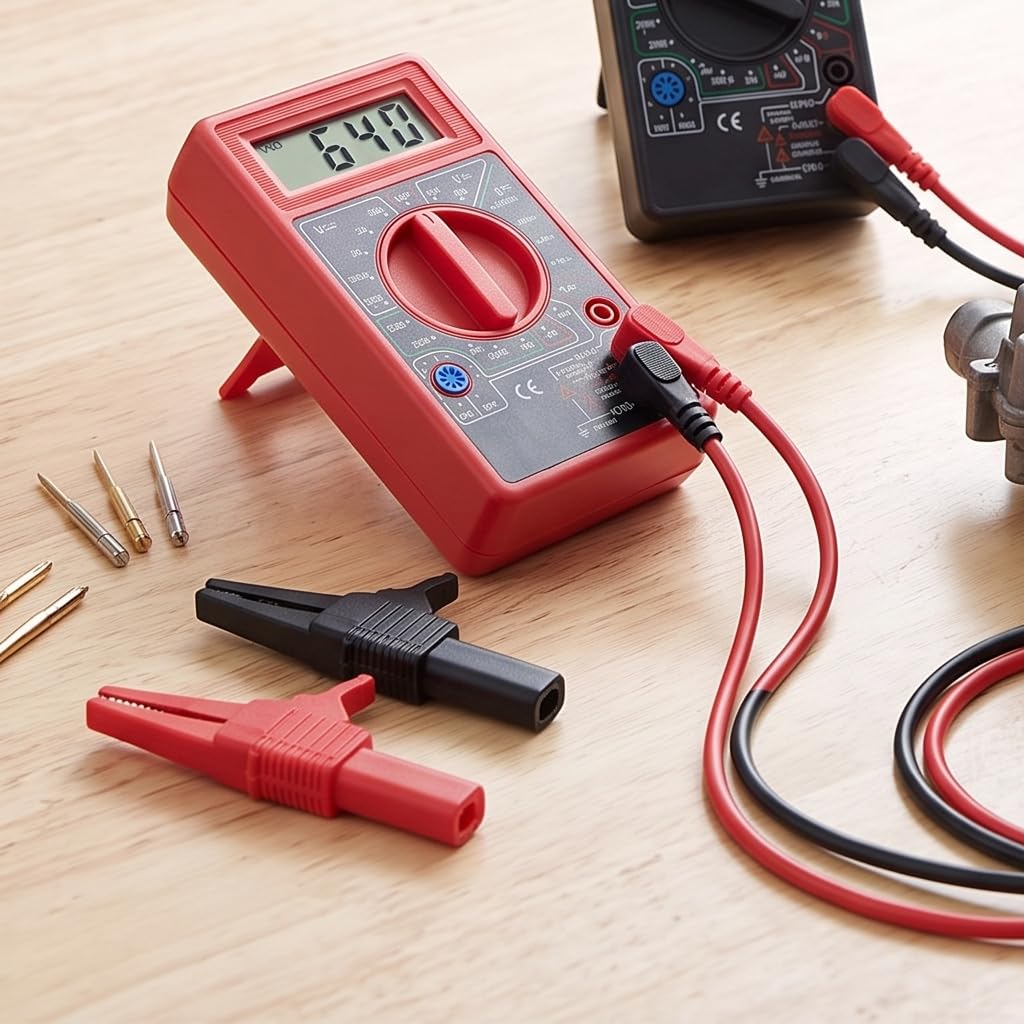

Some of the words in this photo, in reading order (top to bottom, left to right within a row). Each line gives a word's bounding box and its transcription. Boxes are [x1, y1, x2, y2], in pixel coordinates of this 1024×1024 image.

[716, 111, 744, 133] CE
[308, 102, 426, 172] 640
[514, 378, 544, 400] CE
